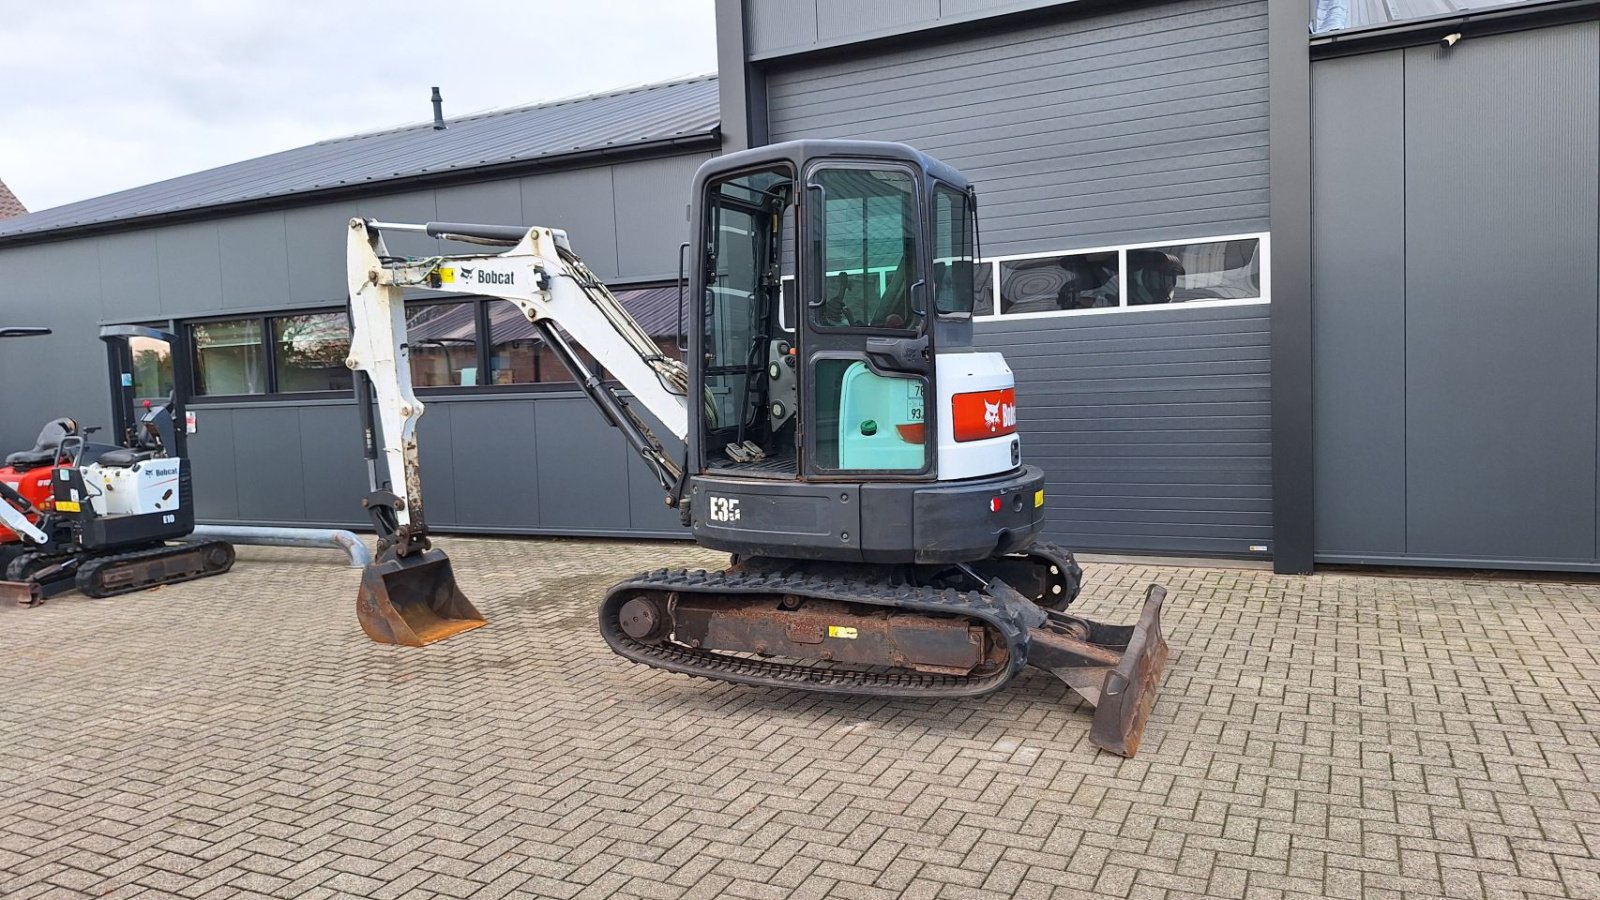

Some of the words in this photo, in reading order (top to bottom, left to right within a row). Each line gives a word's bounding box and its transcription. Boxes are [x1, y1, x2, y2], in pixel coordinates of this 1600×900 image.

[477, 269, 515, 285] Bobcat
[911, 408, 921, 419] 93
[155, 468, 178, 477] Bobcat
[710, 496, 741, 522] E35
[162, 514, 175, 524] E10
